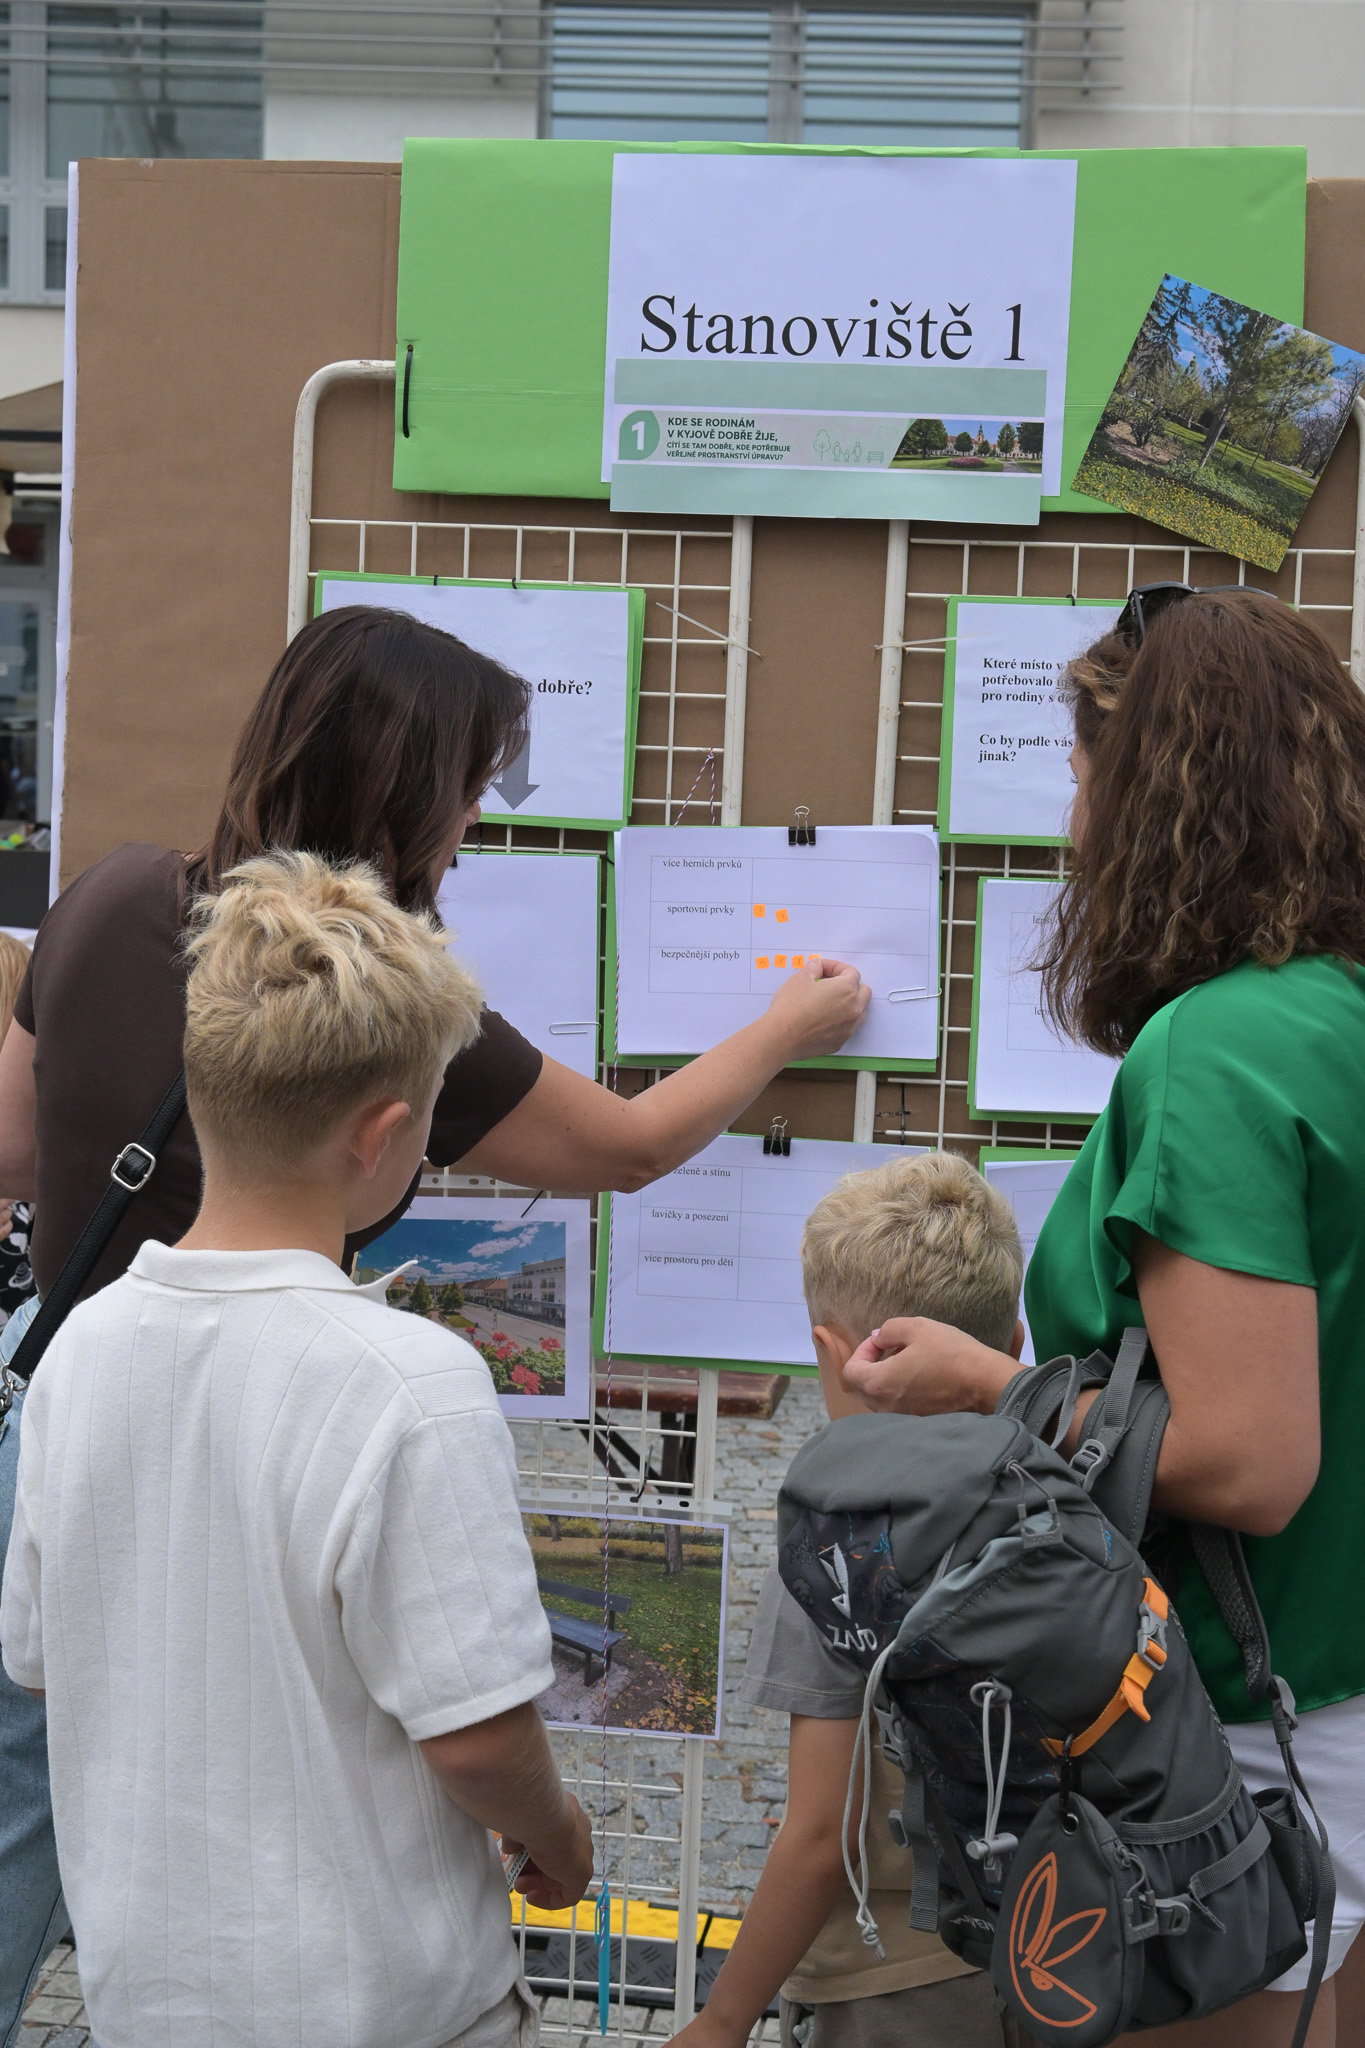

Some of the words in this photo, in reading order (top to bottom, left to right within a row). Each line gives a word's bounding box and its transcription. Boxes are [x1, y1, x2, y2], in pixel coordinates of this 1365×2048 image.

[640, 295, 973, 361] Stanoviště
[1003, 303, 1026, 361] 1
[668, 417, 688, 426] KDE
[690, 418, 703, 426] SE
[705, 417, 755, 428] RODINÁM
[631, 420, 646, 450] 1
[667, 429, 675, 438] V
[677, 428, 716, 439] KYJOVĚ
[718, 429, 753, 440] DOBŘE
[755, 430, 778, 442] ŽIJE,
[667, 441, 681, 449] CÍTÍ
[708, 442, 734, 451] DOBŘE,
[751, 444, 791, 452] POTŘEBUJE
[667, 450, 697, 458] VEŘEJNÉ
[697, 452, 750, 460] PROSTRANSTVÍ
[751, 452, 784, 461] ÚPRAVU?
[983, 657, 1017, 670] Které
[1020, 659, 1053, 671] místo
[537, 679, 593, 695] dobře?
[982, 674, 1053, 687] potřebovalo
[981, 692, 1002, 703] pro
[1006, 691, 1045, 705] rodiny
[1048, 694, 1054, 703] s
[979, 733, 997, 745] Co
[1000, 734, 1015, 748] by
[1018, 735, 1050, 749] podle
[1054, 736, 1073, 748] vás
[978, 750, 1017, 764] jinak?
[662, 858, 681, 868] více
[683, 859, 715, 868] herních
[717, 859, 742, 870] prvků
[667, 904, 708, 915] sportovní
[710, 904, 735, 916] prvky
[661, 948, 711, 961] bezpečnější
[712, 950, 740, 961] pohyb
[673, 1166, 701, 1176] zeleně
[710, 1168, 731, 1177] stínu
[652, 1209, 682, 1221] lavičky
[692, 1212, 729, 1222] posezení
[644, 1253, 662, 1263] více
[663, 1256, 699, 1265] prostoru
[701, 1258, 716, 1267] pro
[717, 1258, 734, 1267] děti
